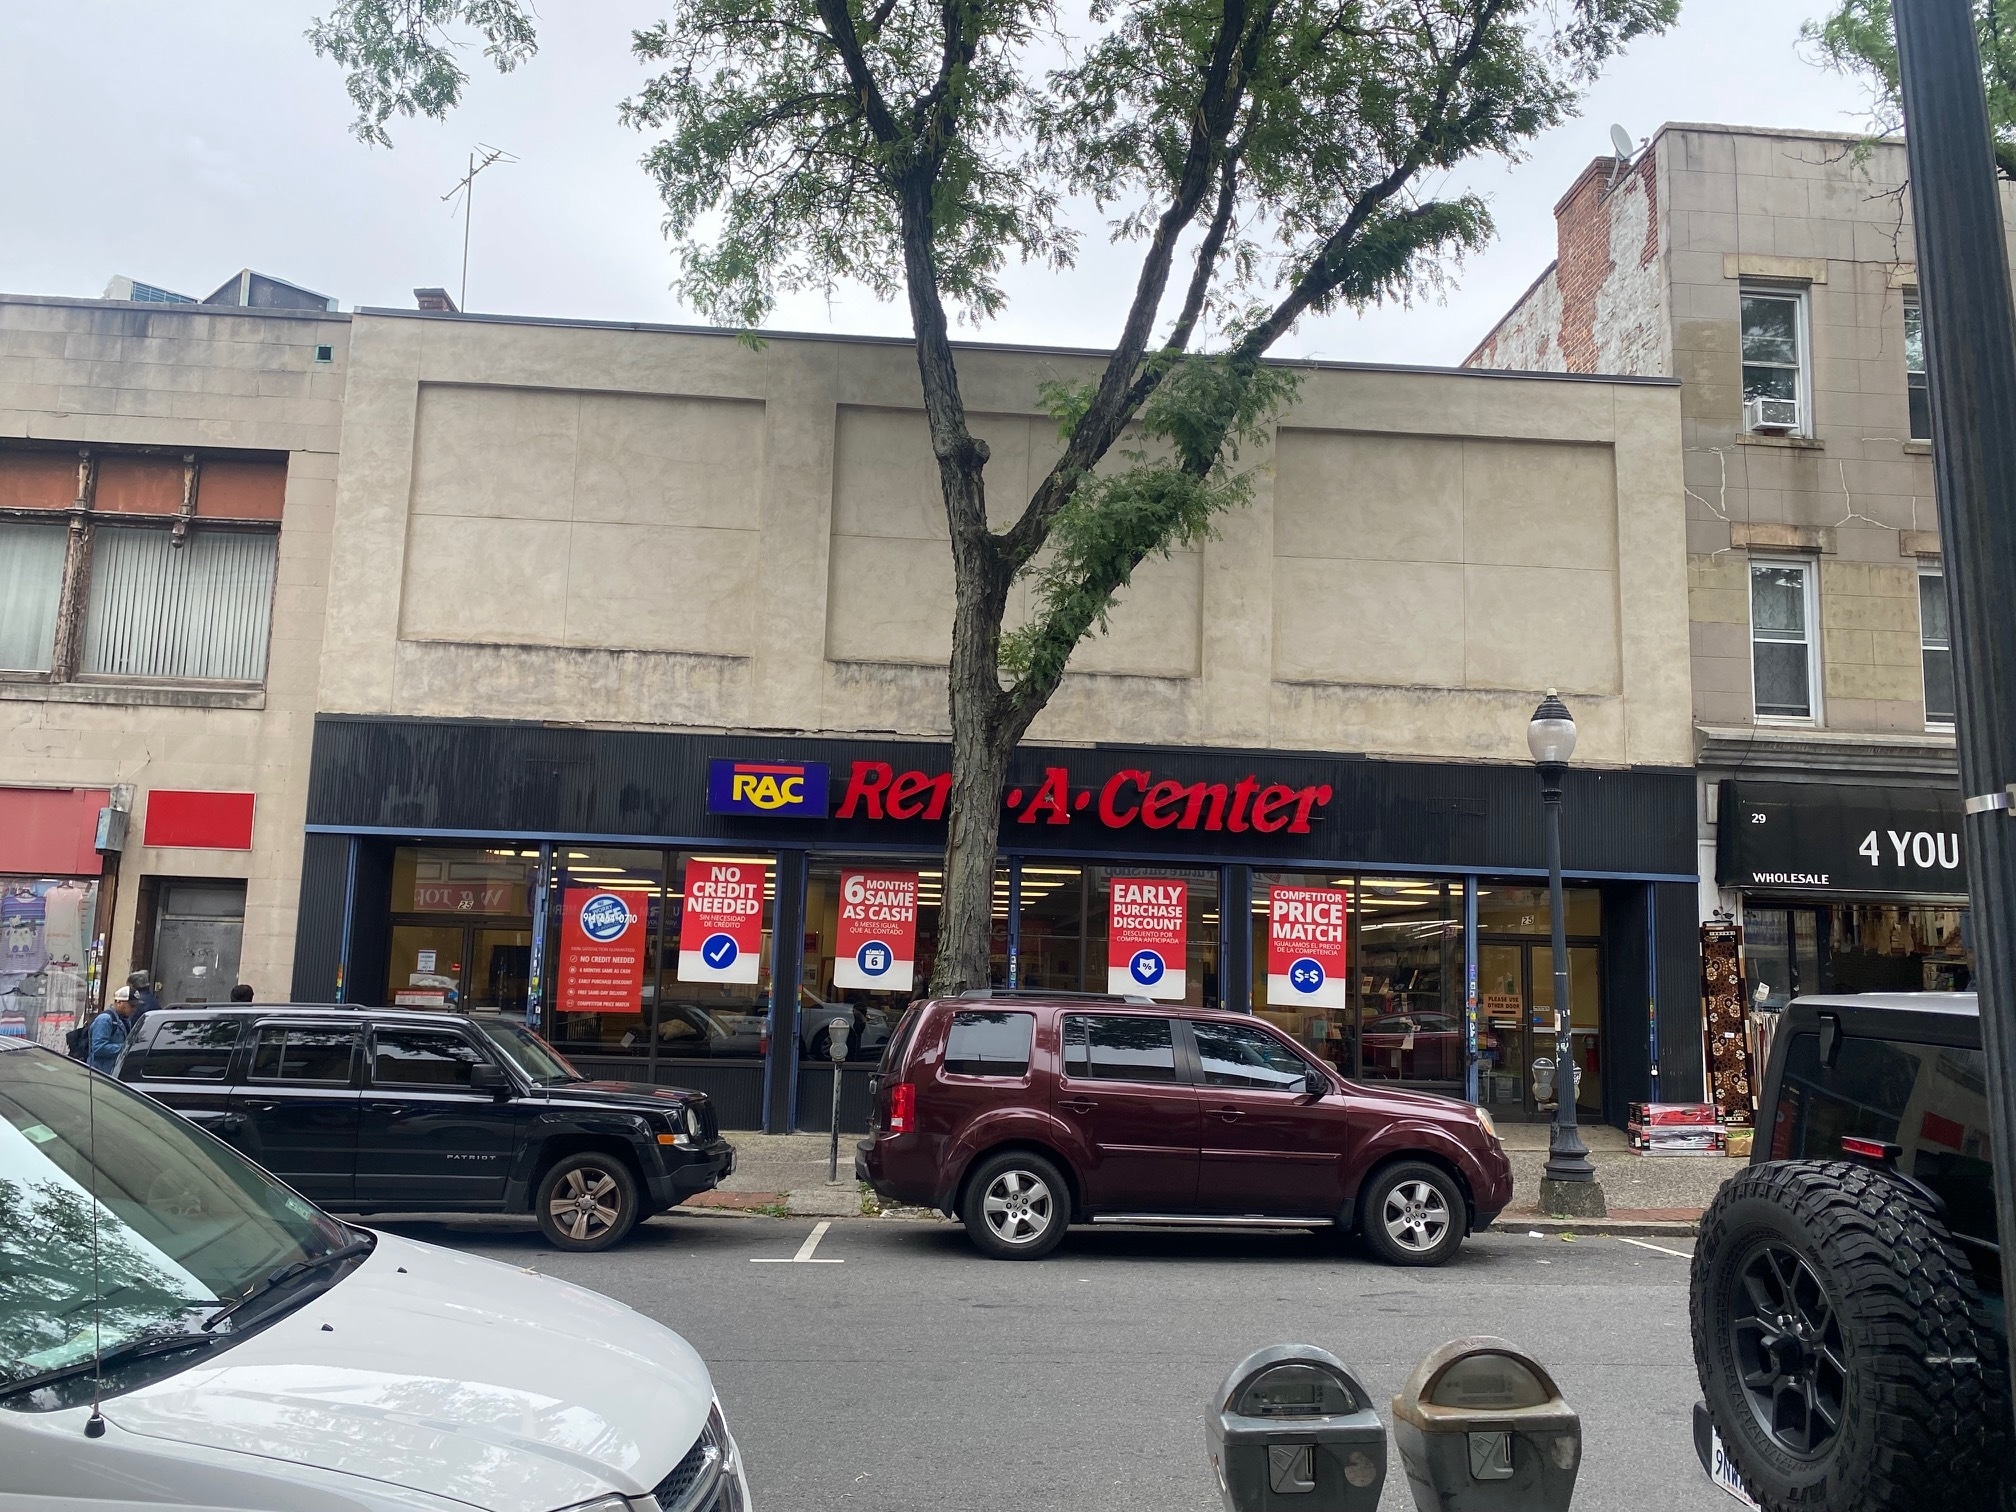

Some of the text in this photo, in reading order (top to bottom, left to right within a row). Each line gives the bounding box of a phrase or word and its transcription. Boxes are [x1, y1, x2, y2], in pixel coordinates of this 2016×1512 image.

[732, 774, 804, 809] RAC
[1751, 813, 1766, 824] 29
[1858, 830, 1959, 869] 4 YOU
[711, 866, 740, 882] NO
[1752, 872, 1829, 885] WHOLESALE
[692, 882, 757, 899] CREDIT
[844, 876, 914, 904] 6 MONTHS
[1114, 884, 1183, 905] EARLY
[1274, 890, 1343, 903] COMPETITOR
[687, 897, 759, 915] NEEDED
[865, 890, 914, 907] SAME
[843, 905, 913, 922] AS CASH
[1114, 904, 1183, 918] PURCHASE
[1273, 901, 1343, 925] PRICE
[1114, 916, 1183, 930] DISCOUNT
[1523, 916, 1534, 925] 25
[872, 928, 904, 936] CONTADO
[1273, 922, 1342, 943] MATCH
[1274, 941, 1310, 949] IGUALAMOS
[1295, 948, 1338, 956] COMPETENCIA
[612, 956, 635, 964] NEEDED
